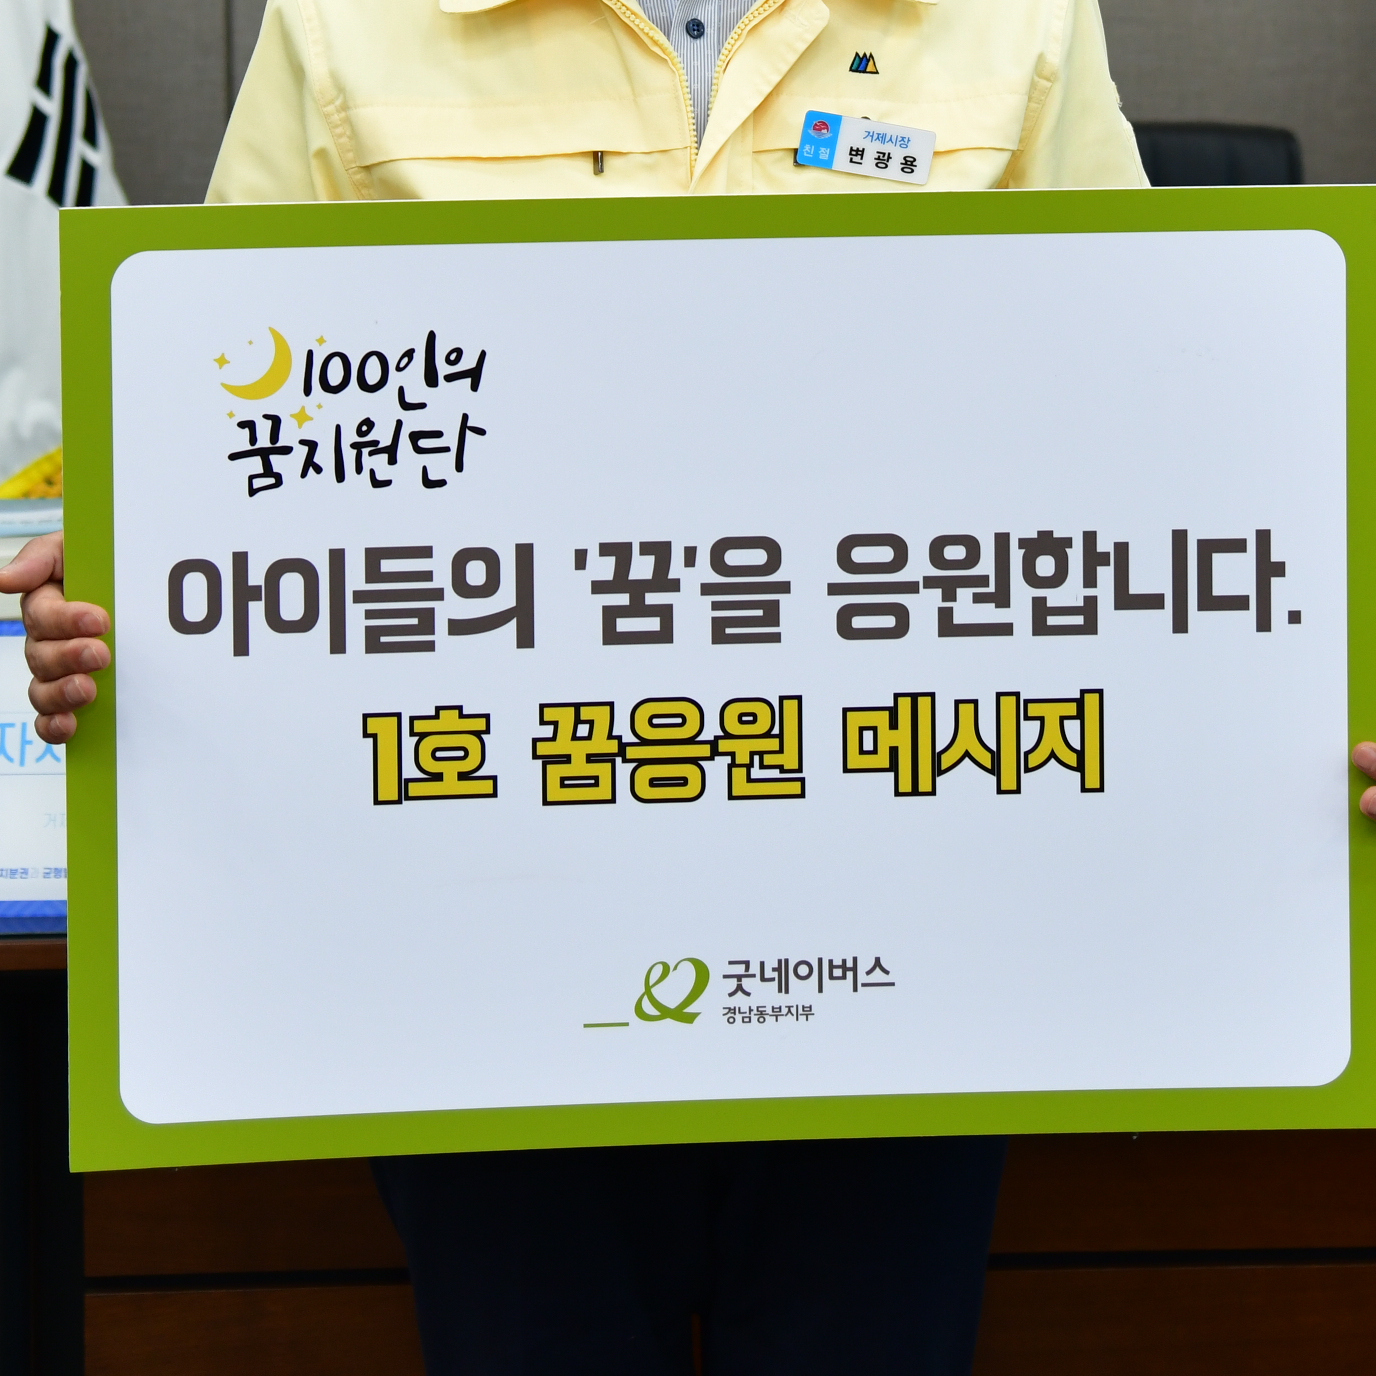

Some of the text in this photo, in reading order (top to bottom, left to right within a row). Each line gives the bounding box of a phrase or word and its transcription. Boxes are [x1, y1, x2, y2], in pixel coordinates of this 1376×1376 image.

[803, 143, 831, 161] 친절
[848, 145, 918, 175] 변광용
[863, 130, 911, 149] 거제시장
[303, 329, 486, 411] 100인의
[228, 413, 486, 498] 꿈지원단
[167, 529, 1302, 657] 아이들의 '꿈'을 응원합니다.
[362, 688, 1105, 807] 1호 꿈응원 메시지
[722, 956, 896, 998] 굿네이버스
[722, 1004, 815, 1024] 경남동부지부
